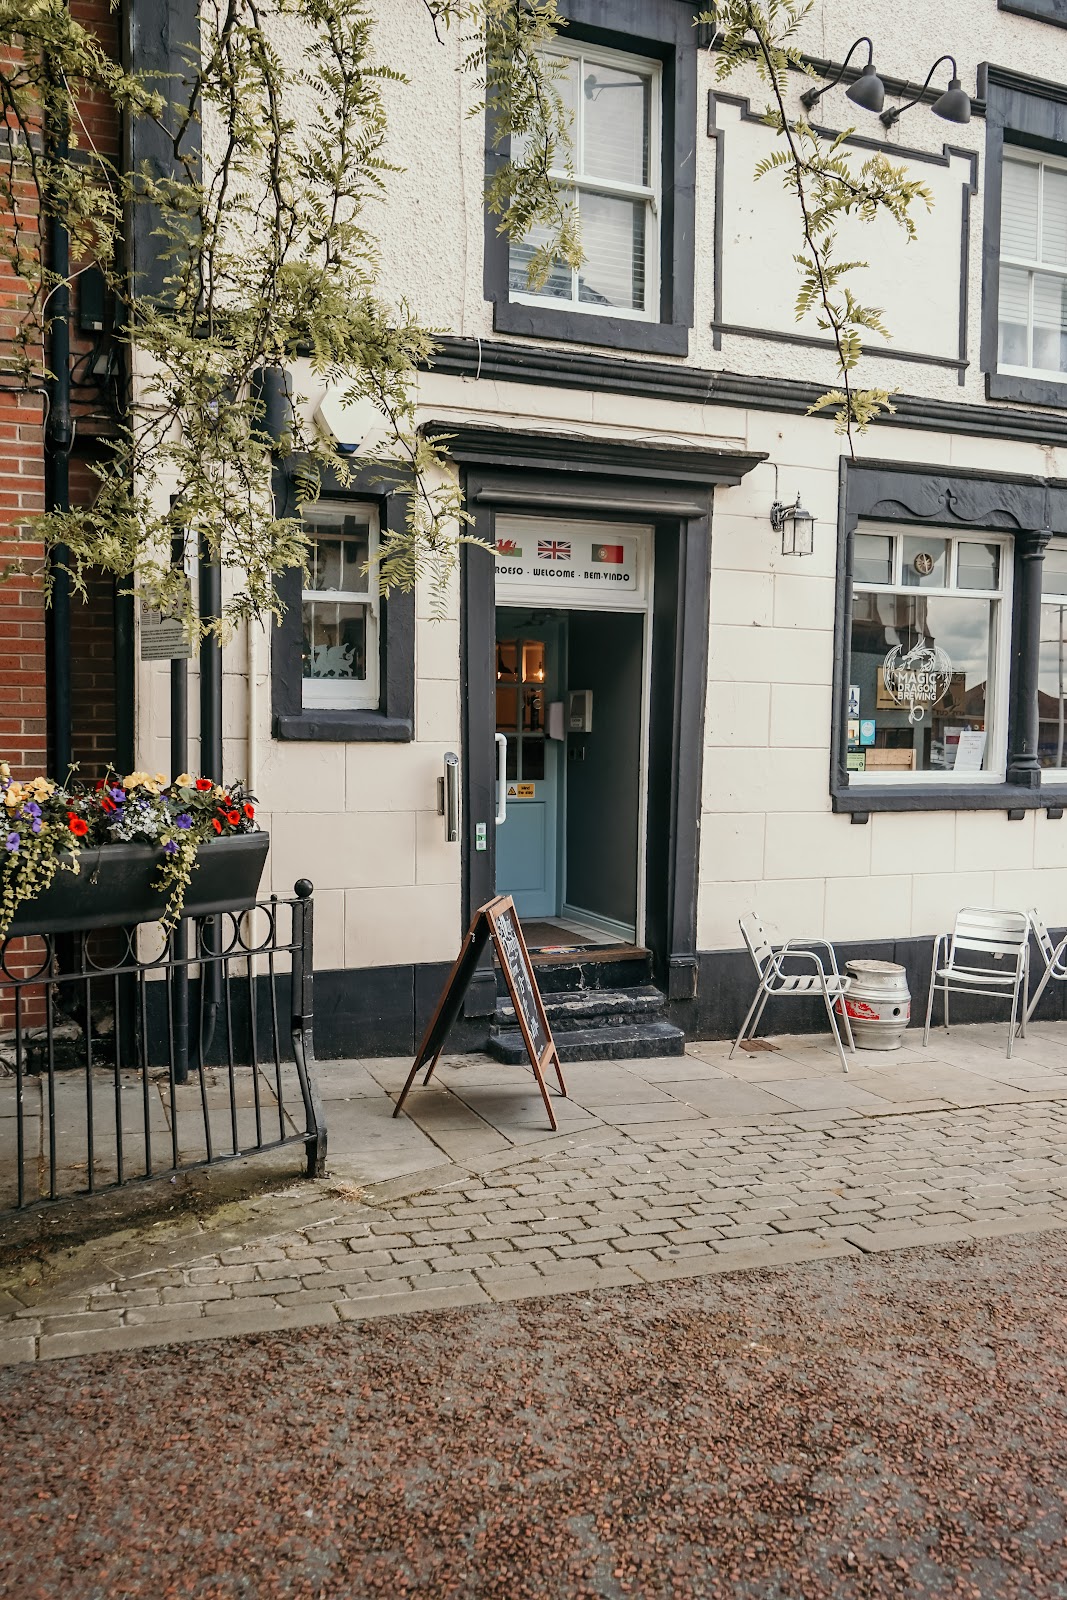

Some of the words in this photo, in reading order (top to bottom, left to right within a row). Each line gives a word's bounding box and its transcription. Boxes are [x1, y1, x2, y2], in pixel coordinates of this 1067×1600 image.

[495, 566, 524, 575] ROESO
[533, 568, 575, 578] WELCOME
[584, 571, 630, 581] BEM-VINDO
[898, 672, 937, 684] MAGIC
[898, 684, 937, 692] DRAGON
[898, 692, 937, 701] BREWING
